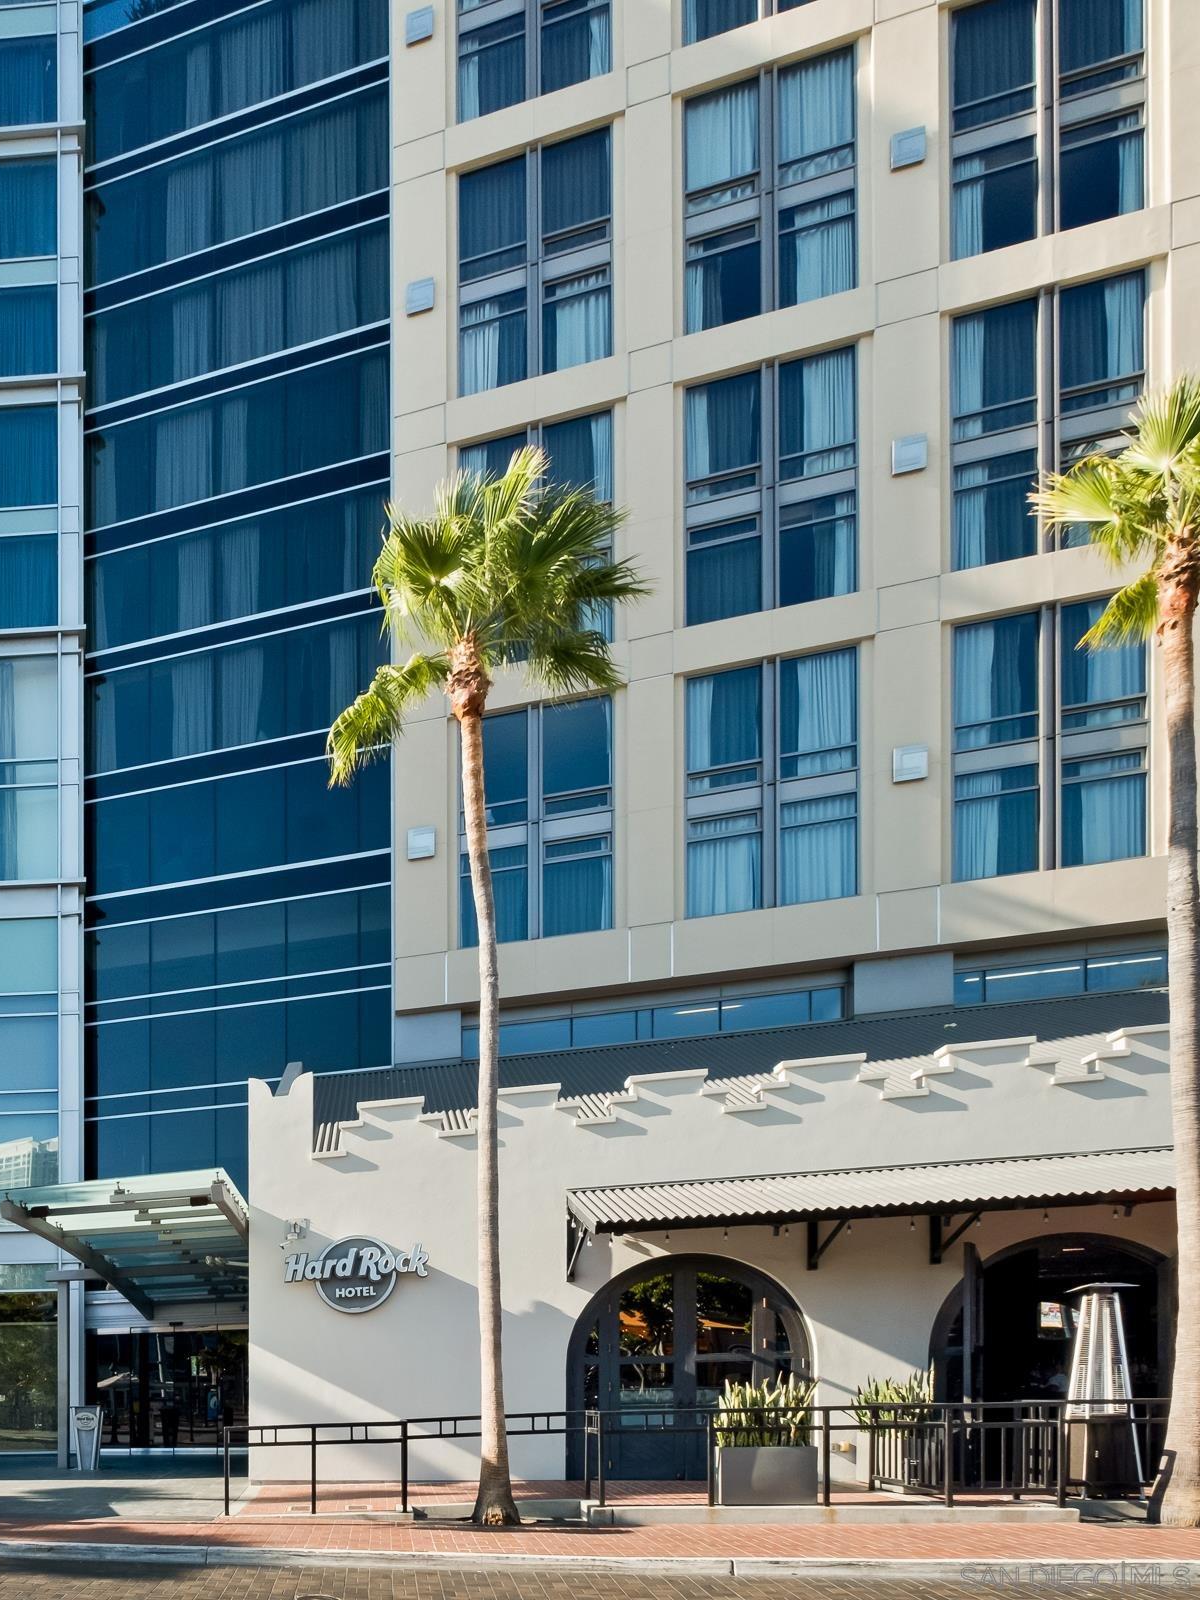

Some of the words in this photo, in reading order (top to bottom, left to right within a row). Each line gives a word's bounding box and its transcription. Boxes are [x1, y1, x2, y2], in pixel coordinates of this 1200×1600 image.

[284, 1247, 357, 1283] Hard
[358, 1242, 429, 1281] Rock
[335, 1285, 377, 1299] HOTEL
